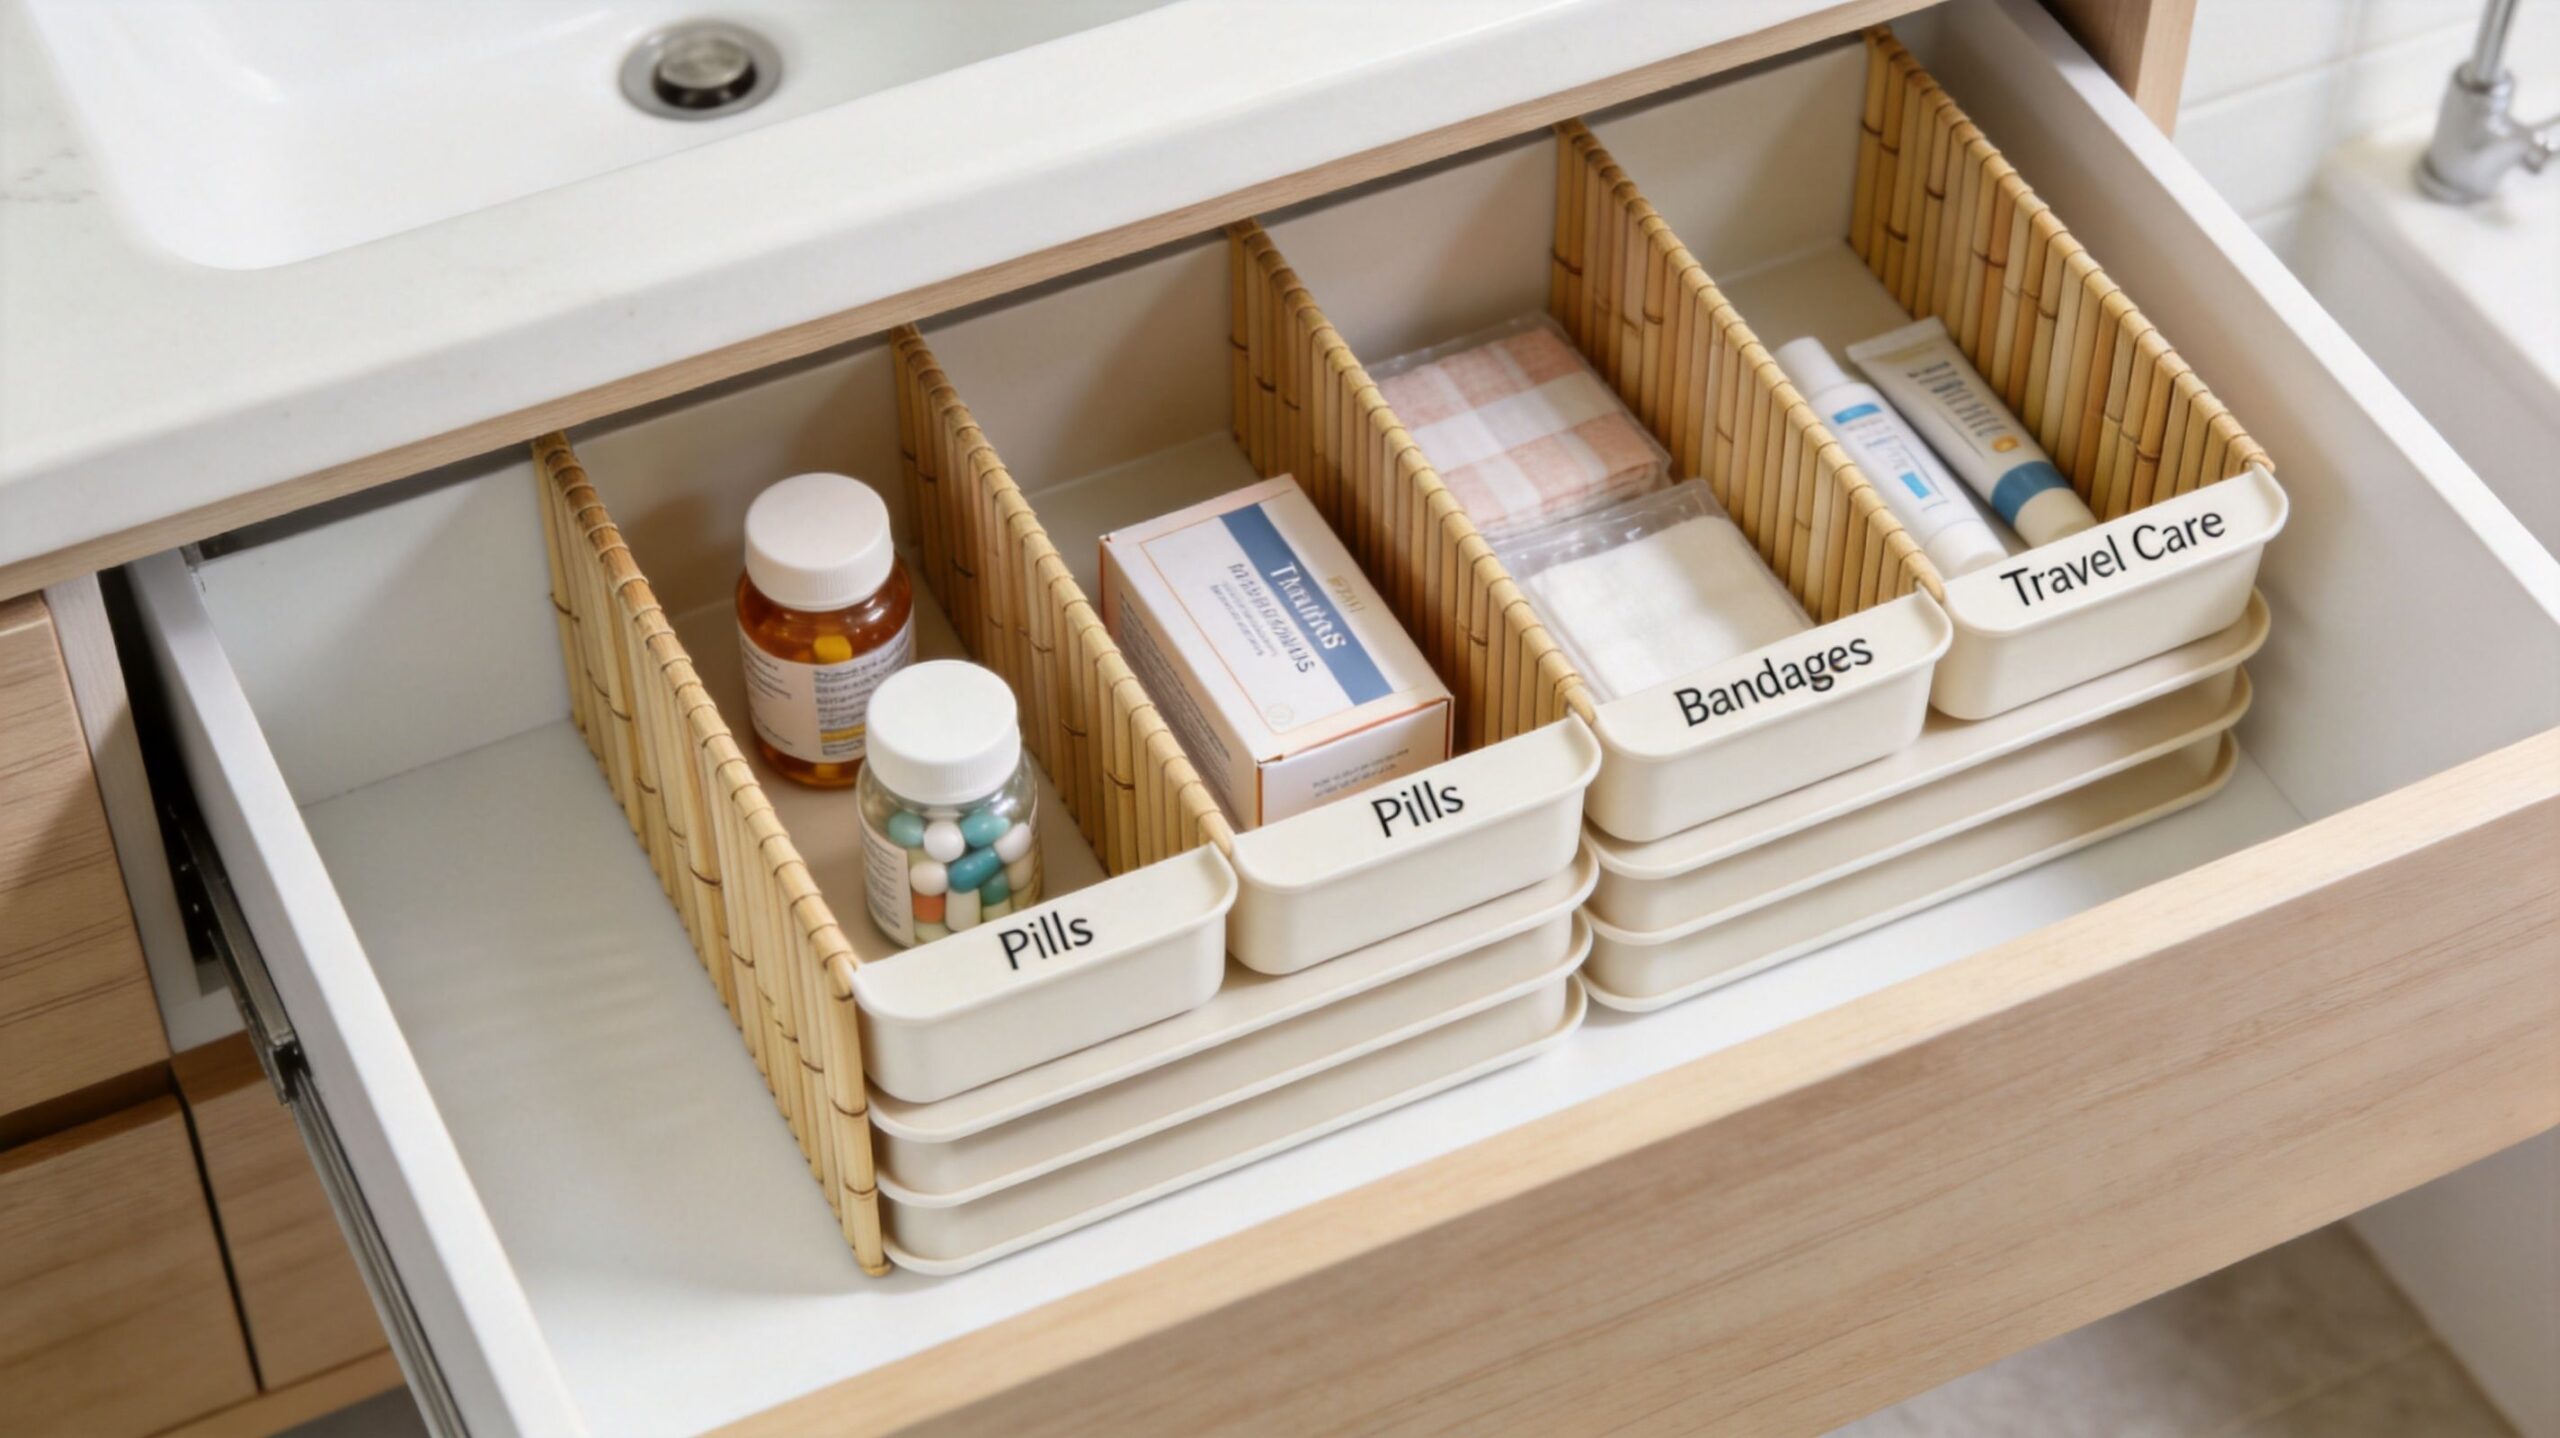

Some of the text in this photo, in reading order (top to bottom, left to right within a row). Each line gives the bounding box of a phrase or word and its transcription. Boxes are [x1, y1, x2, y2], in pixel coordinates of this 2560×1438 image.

[2000, 512, 2226, 607] Travel Care
[1673, 637, 1874, 728] Bandages
[1370, 780, 1465, 838] Pills
[997, 910, 1094, 970] Pills
